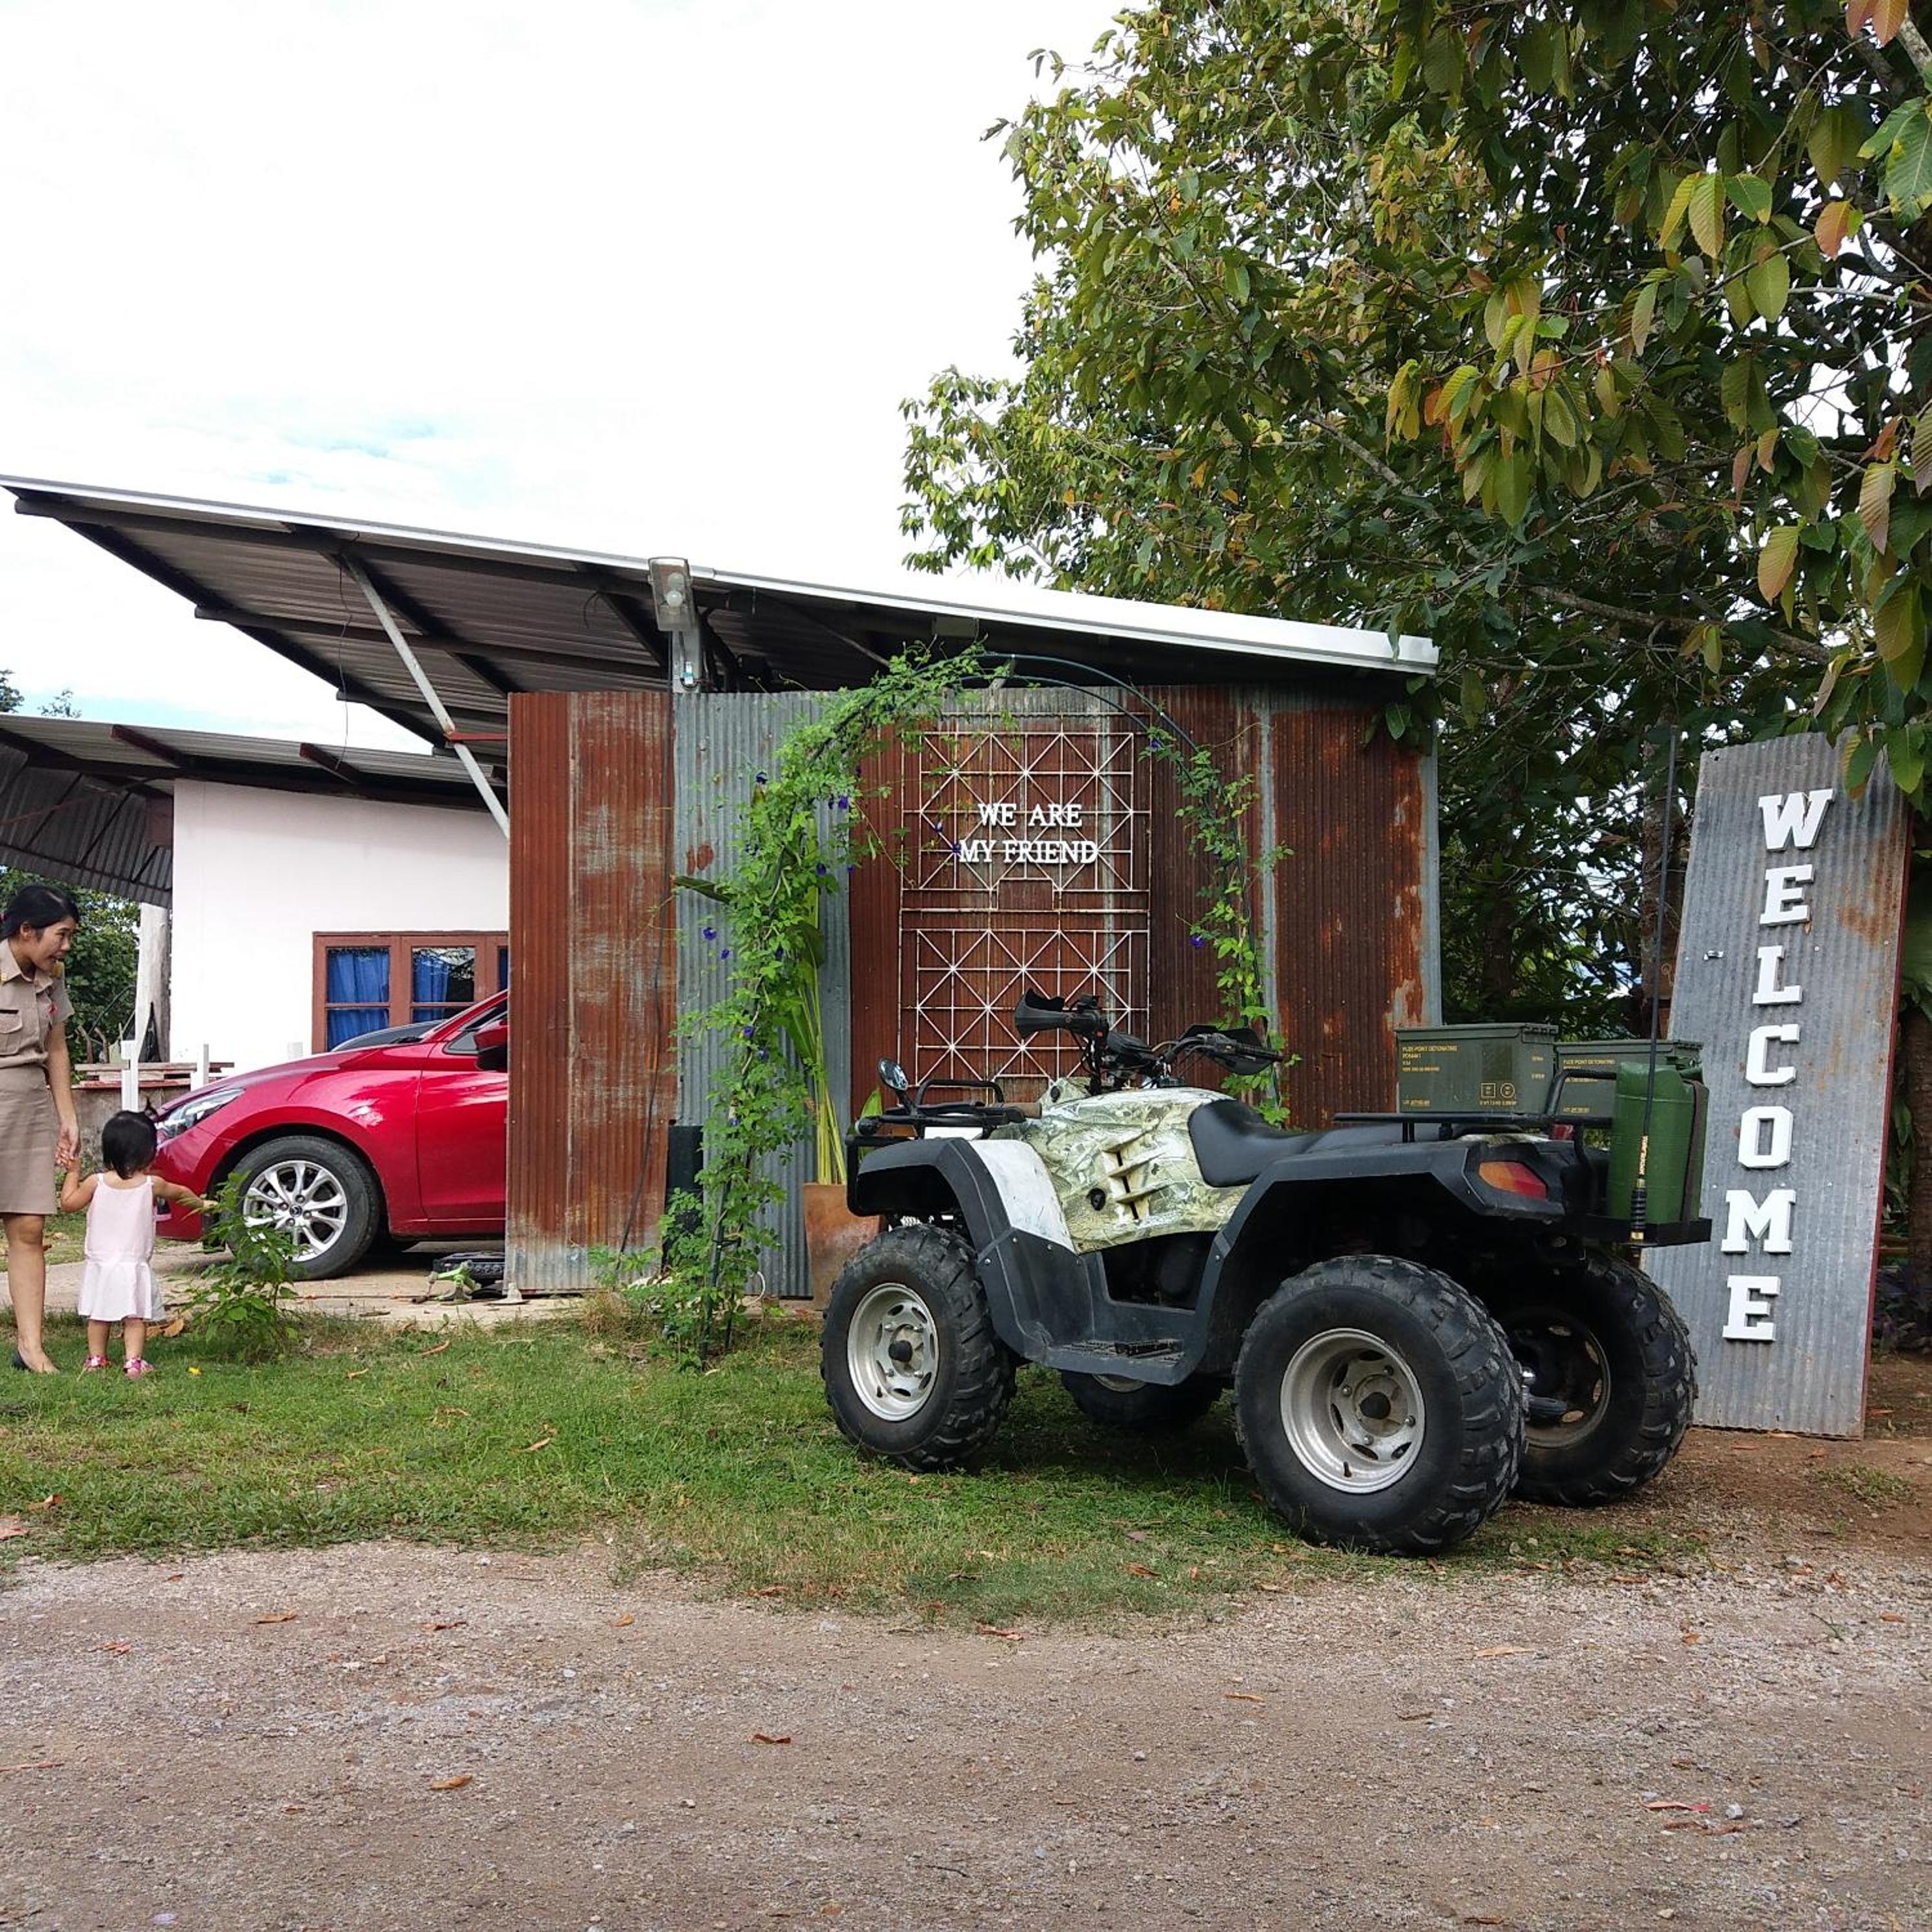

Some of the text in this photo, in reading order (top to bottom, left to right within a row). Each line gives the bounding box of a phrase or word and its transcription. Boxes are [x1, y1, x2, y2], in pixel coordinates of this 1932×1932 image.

[978, 804, 1083, 827] WE ARE
[959, 839, 1098, 863] MY FRIEND
[1721, 789, 1835, 1342] WELCOME
